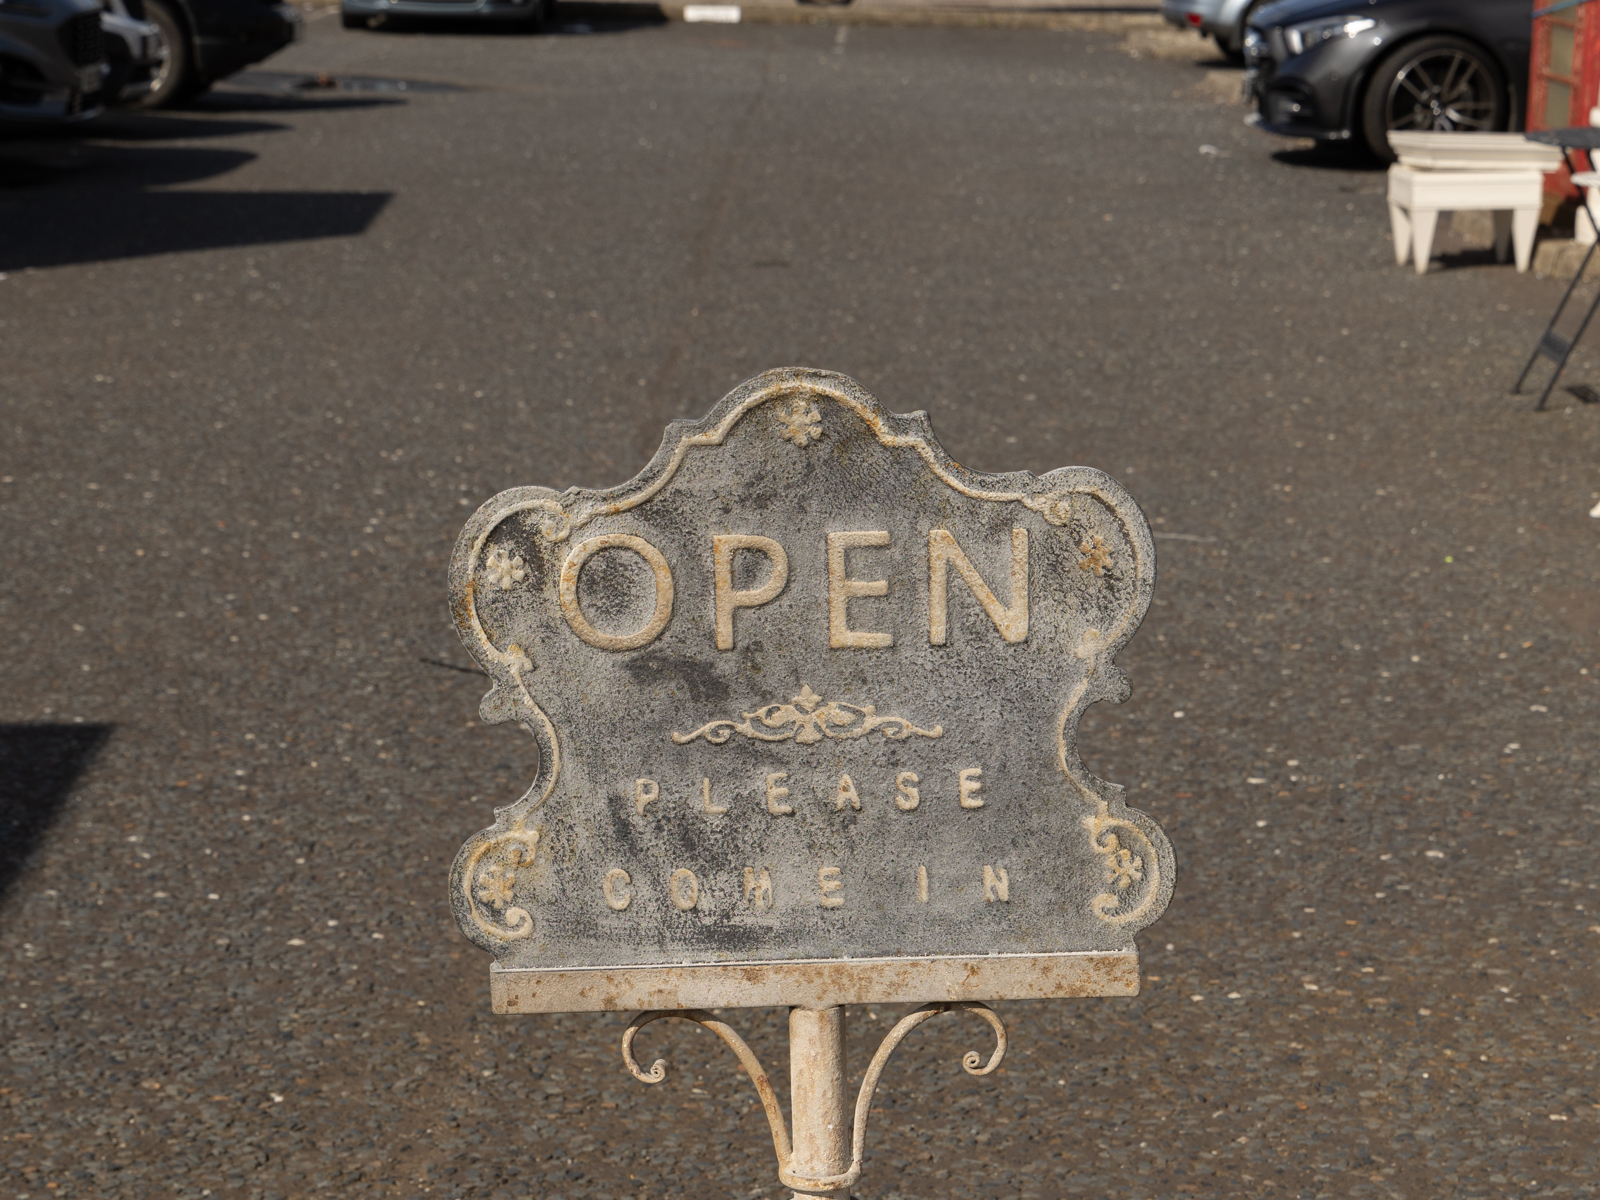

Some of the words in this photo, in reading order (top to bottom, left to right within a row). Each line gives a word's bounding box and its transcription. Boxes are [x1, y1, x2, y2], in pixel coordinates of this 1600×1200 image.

[560, 528, 1030, 651] OPEN
[635, 768, 985, 816] PLEASE
[603, 866, 846, 911] COME
[917, 864, 1010, 903] IN
